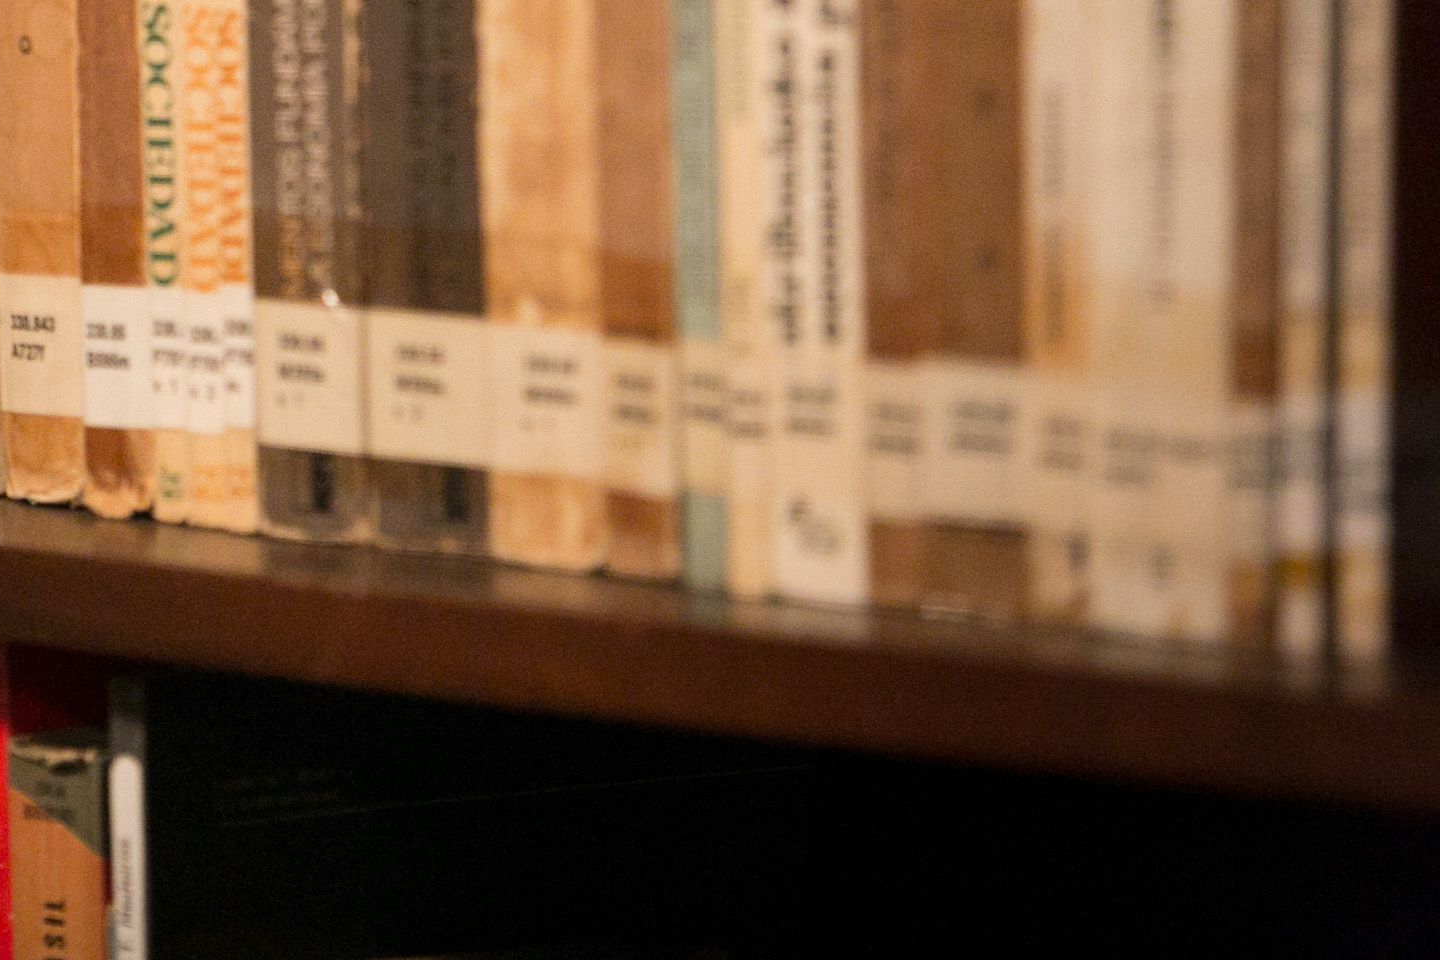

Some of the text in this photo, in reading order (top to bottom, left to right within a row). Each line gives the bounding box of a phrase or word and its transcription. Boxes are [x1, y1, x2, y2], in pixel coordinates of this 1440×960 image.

[143, 1, 180, 287] SOCIEDAD
[183, 6, 218, 293] SOCIEDAD
[218, 9, 249, 285] SOCIEDAD
